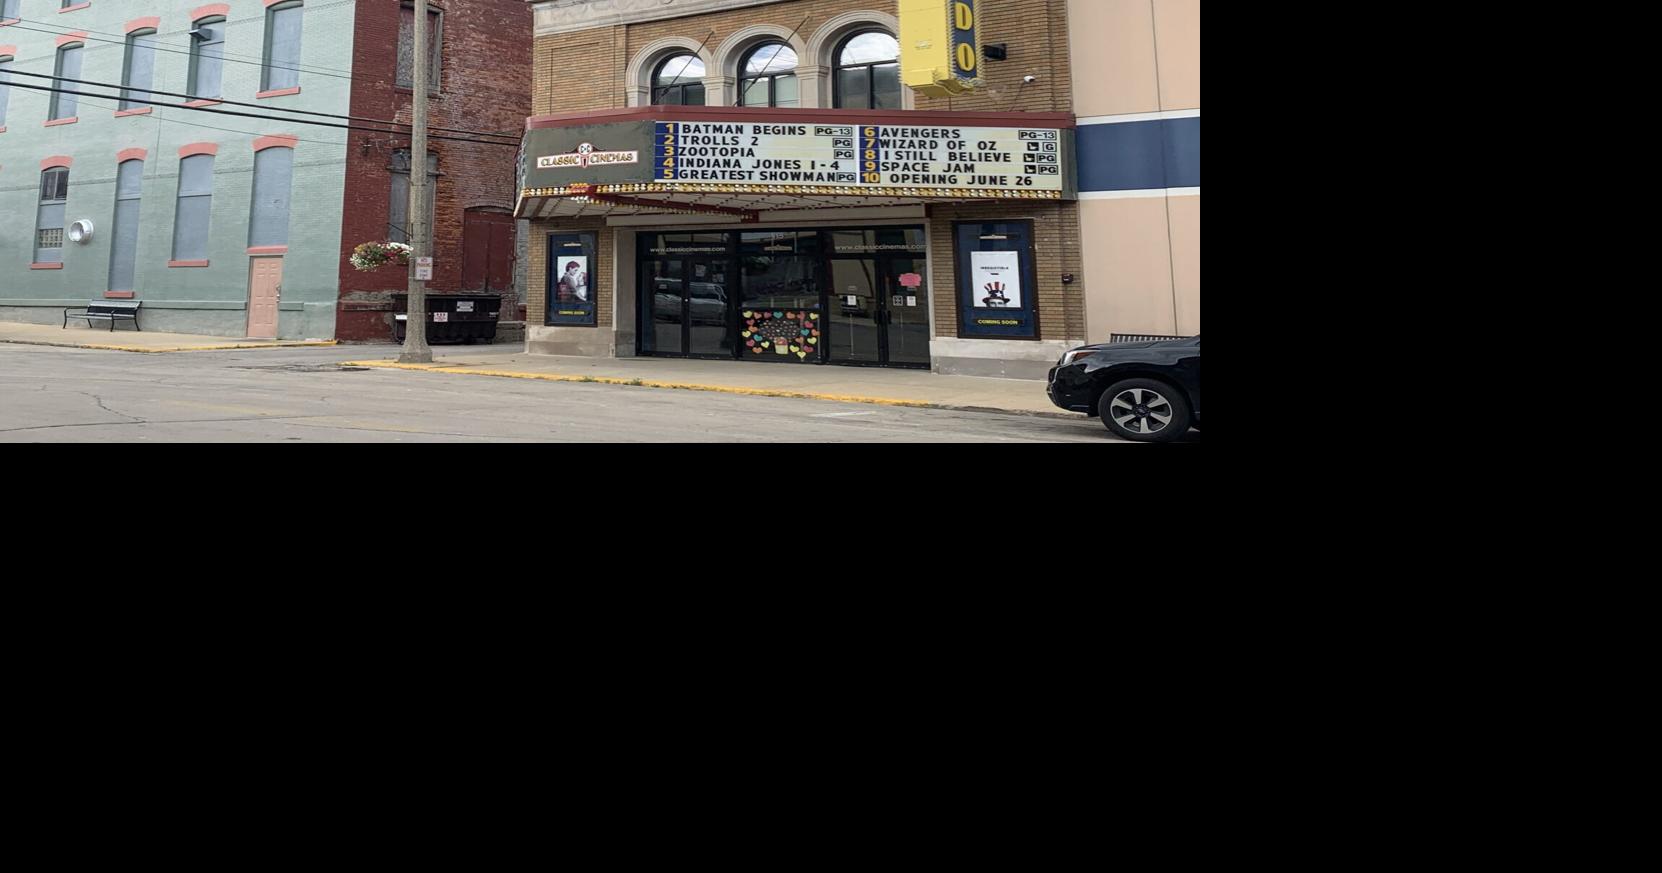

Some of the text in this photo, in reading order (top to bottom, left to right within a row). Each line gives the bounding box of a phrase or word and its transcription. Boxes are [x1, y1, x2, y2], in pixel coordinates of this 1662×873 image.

[665, 124, 851, 136] 1 BATMAN BEGINS PG-13
[864, 127, 1055, 139] 6 AVENGERS PG-13
[664, 135, 851, 147] 2 TROLLS 2 PG
[865, 138, 1055, 151] 7 WIZARD OF OZ G
[664, 147, 852, 158] 3 ZOOTOPIA PG
[864, 150, 1055, 163] 8 I STILL BELIEVE PG
[540, 153, 633, 166] CLASSIC CINEMAS
[663, 158, 674, 168] 4
[679, 158, 742, 169] INDIANA
[752, 159, 801, 169] JONES
[864, 161, 1057, 174] 9 SPACE JAM PG
[663, 169, 855, 182] 5 GREATEST SHOWMAN PG
[862, 173, 1033, 186] 10 OPENING JUNE 26
